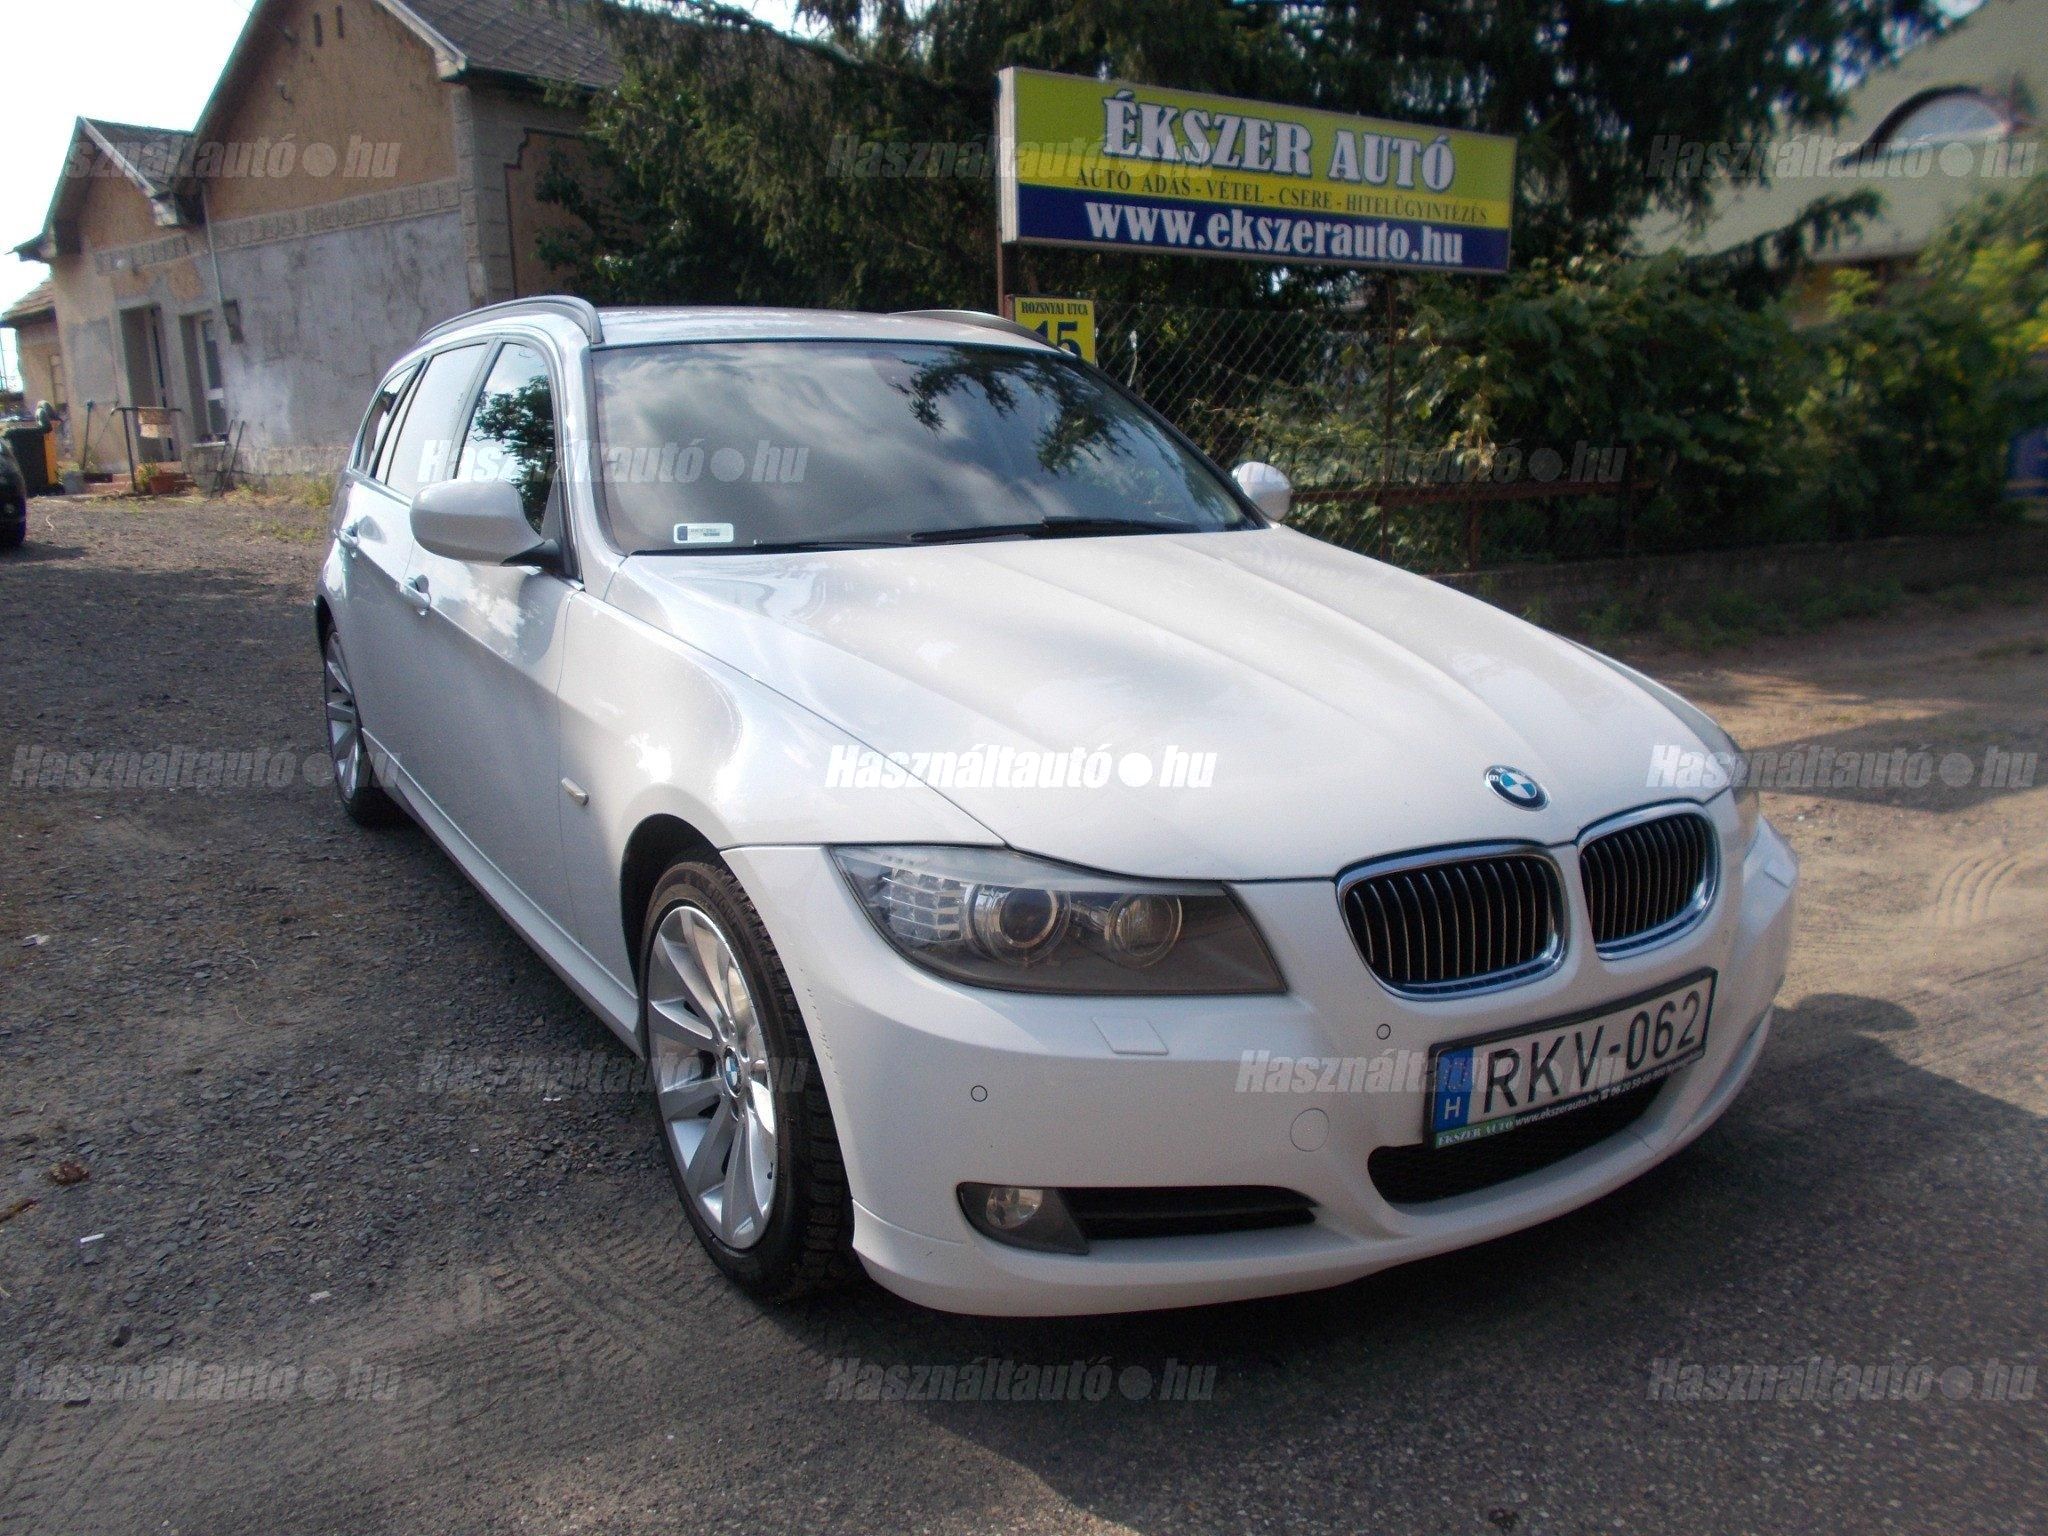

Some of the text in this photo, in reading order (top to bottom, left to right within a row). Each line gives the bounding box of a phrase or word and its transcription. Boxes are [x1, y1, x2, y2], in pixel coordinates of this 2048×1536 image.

[1104, 89, 1312, 178] ÉKSZER
[1329, 134, 1455, 192] AUTÓ
[1076, 164, 1131, 190] AUTÓ
[1142, 170, 1191, 196] ADÁS
[1207, 175, 1264, 203] VÉTEL
[1279, 186, 1332, 209] CSERE
[1085, 201, 1463, 265] www.ekszerauto.hu
[1067, 303, 1089, 316] UTCA
[1483, 991, 1701, 1114] RKV-062
[1444, 1096, 1462, 1120] H
